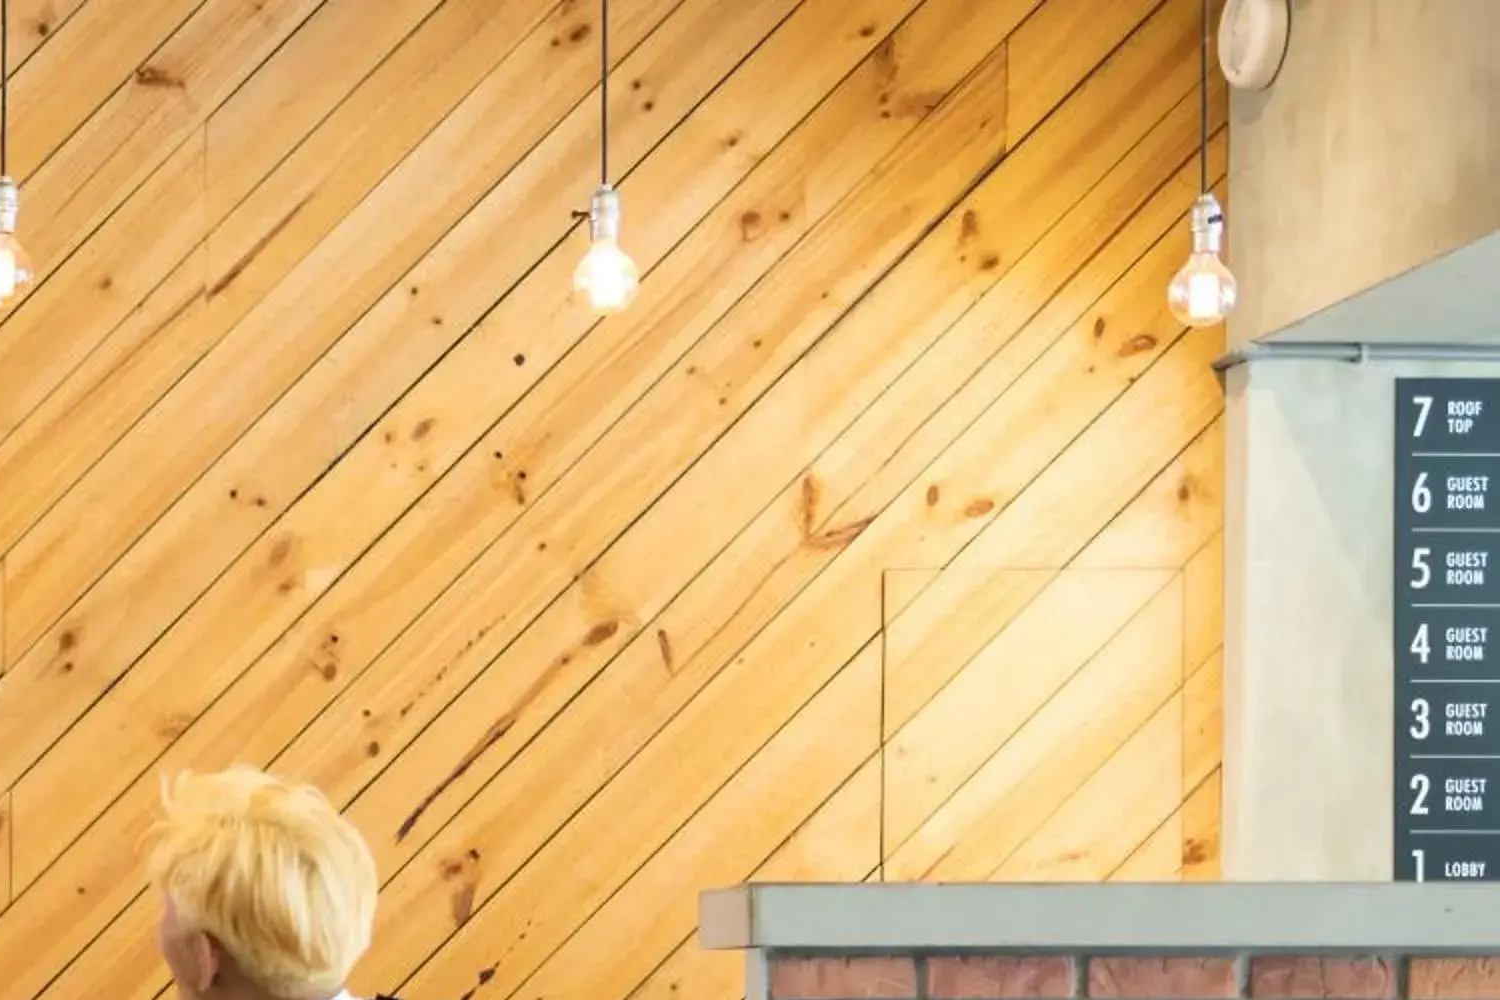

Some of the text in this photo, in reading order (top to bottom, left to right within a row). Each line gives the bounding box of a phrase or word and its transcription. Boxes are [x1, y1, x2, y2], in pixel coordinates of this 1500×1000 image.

[1411, 395, 1434, 438] 7
[1447, 400, 1484, 418] ROOF
[1447, 417, 1475, 434] TOP
[1411, 471, 1433, 514] 6
[1446, 476, 1490, 493] GUEST
[1446, 493, 1485, 510] ROOM
[1409, 546, 1431, 589] 5
[1445, 551, 1489, 568] GUEST
[1445, 568, 1484, 585] ROOM
[1409, 622, 1431, 665] 4
[1445, 627, 1489, 644] GUEST
[1445, 644, 1484, 661] ROOM
[1409, 697, 1431, 740] 3
[1444, 702, 1488, 719] GUEST
[1444, 719, 1483, 736] ROOM
[1409, 772, 1431, 815] 2
[1444, 777, 1488, 794] GUEST
[1444, 794, 1483, 811] ROOM
[1410, 849, 1426, 881] 1
[1444, 861, 1486, 879] LOBBY
